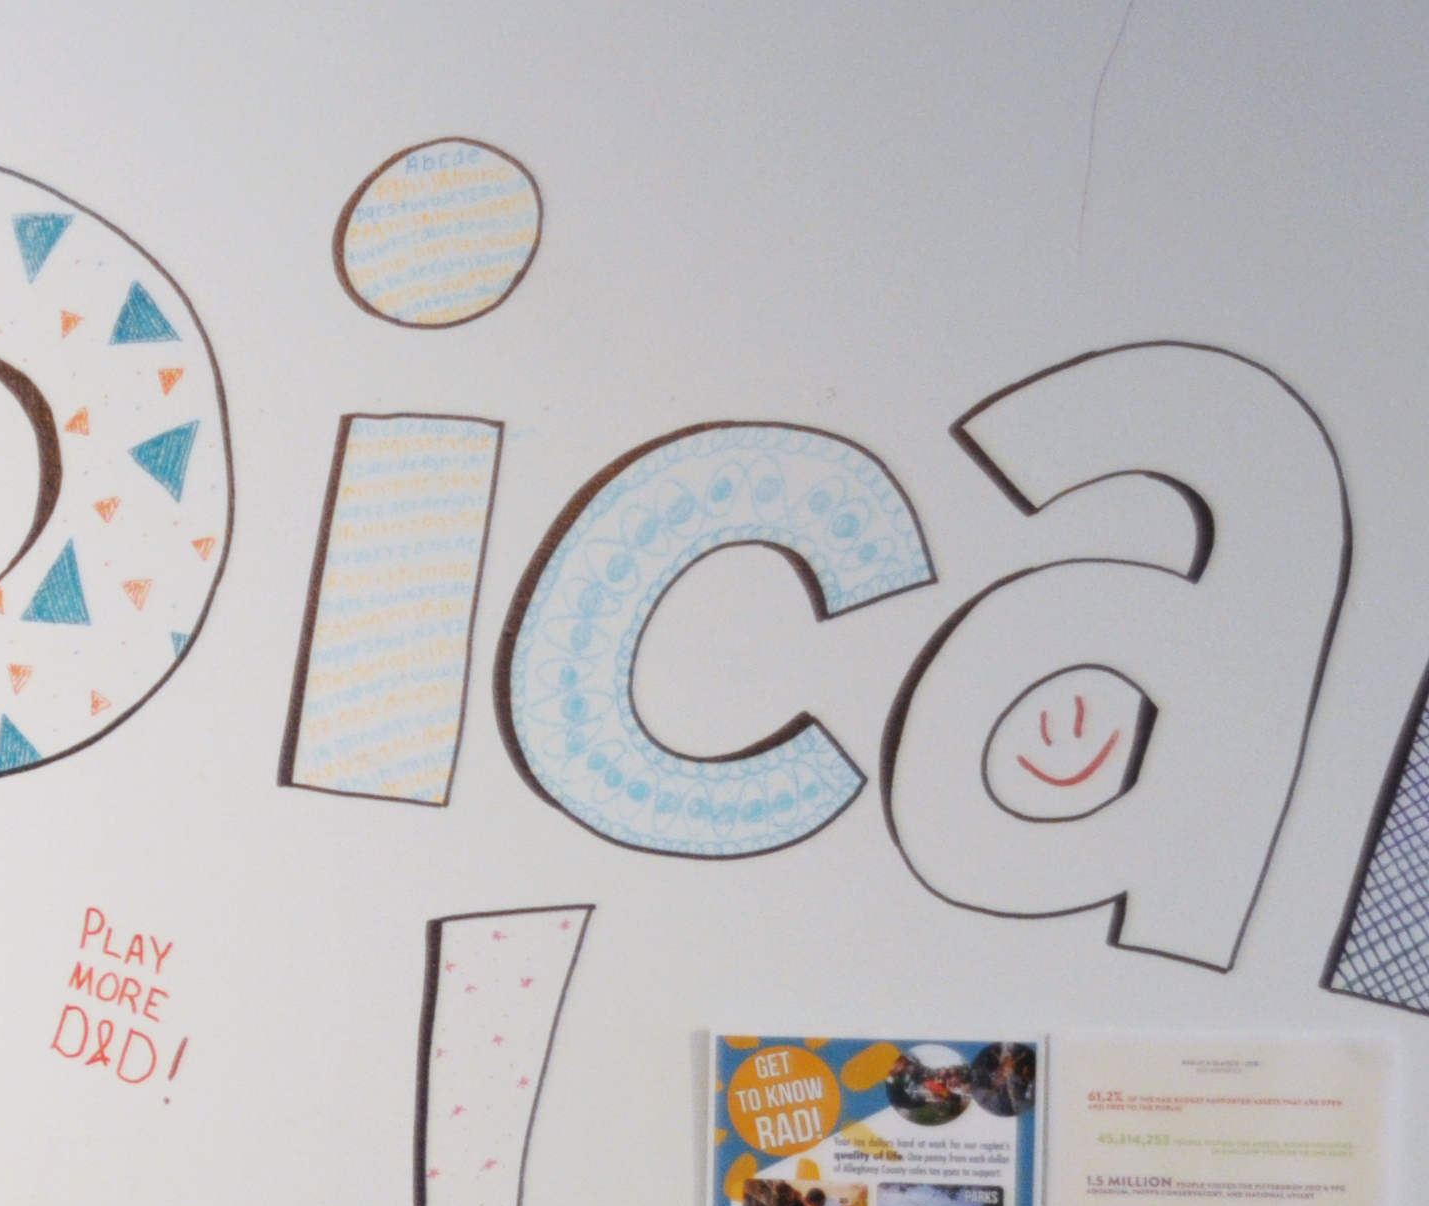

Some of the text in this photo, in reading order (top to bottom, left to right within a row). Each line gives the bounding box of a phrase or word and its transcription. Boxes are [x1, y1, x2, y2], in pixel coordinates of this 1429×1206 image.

[79, 906, 174, 976] PLAY
[68, 961, 171, 1024] MORE
[49, 1003, 190, 1105] D&D!
[754, 1051, 790, 1080] GET
[735, 1076, 824, 1113] TO KNOW
[754, 1107, 824, 1150] RAD!
[964, 1190, 999, 1204] PARKS
[1107, 1176, 1173, 1188] MILLION
